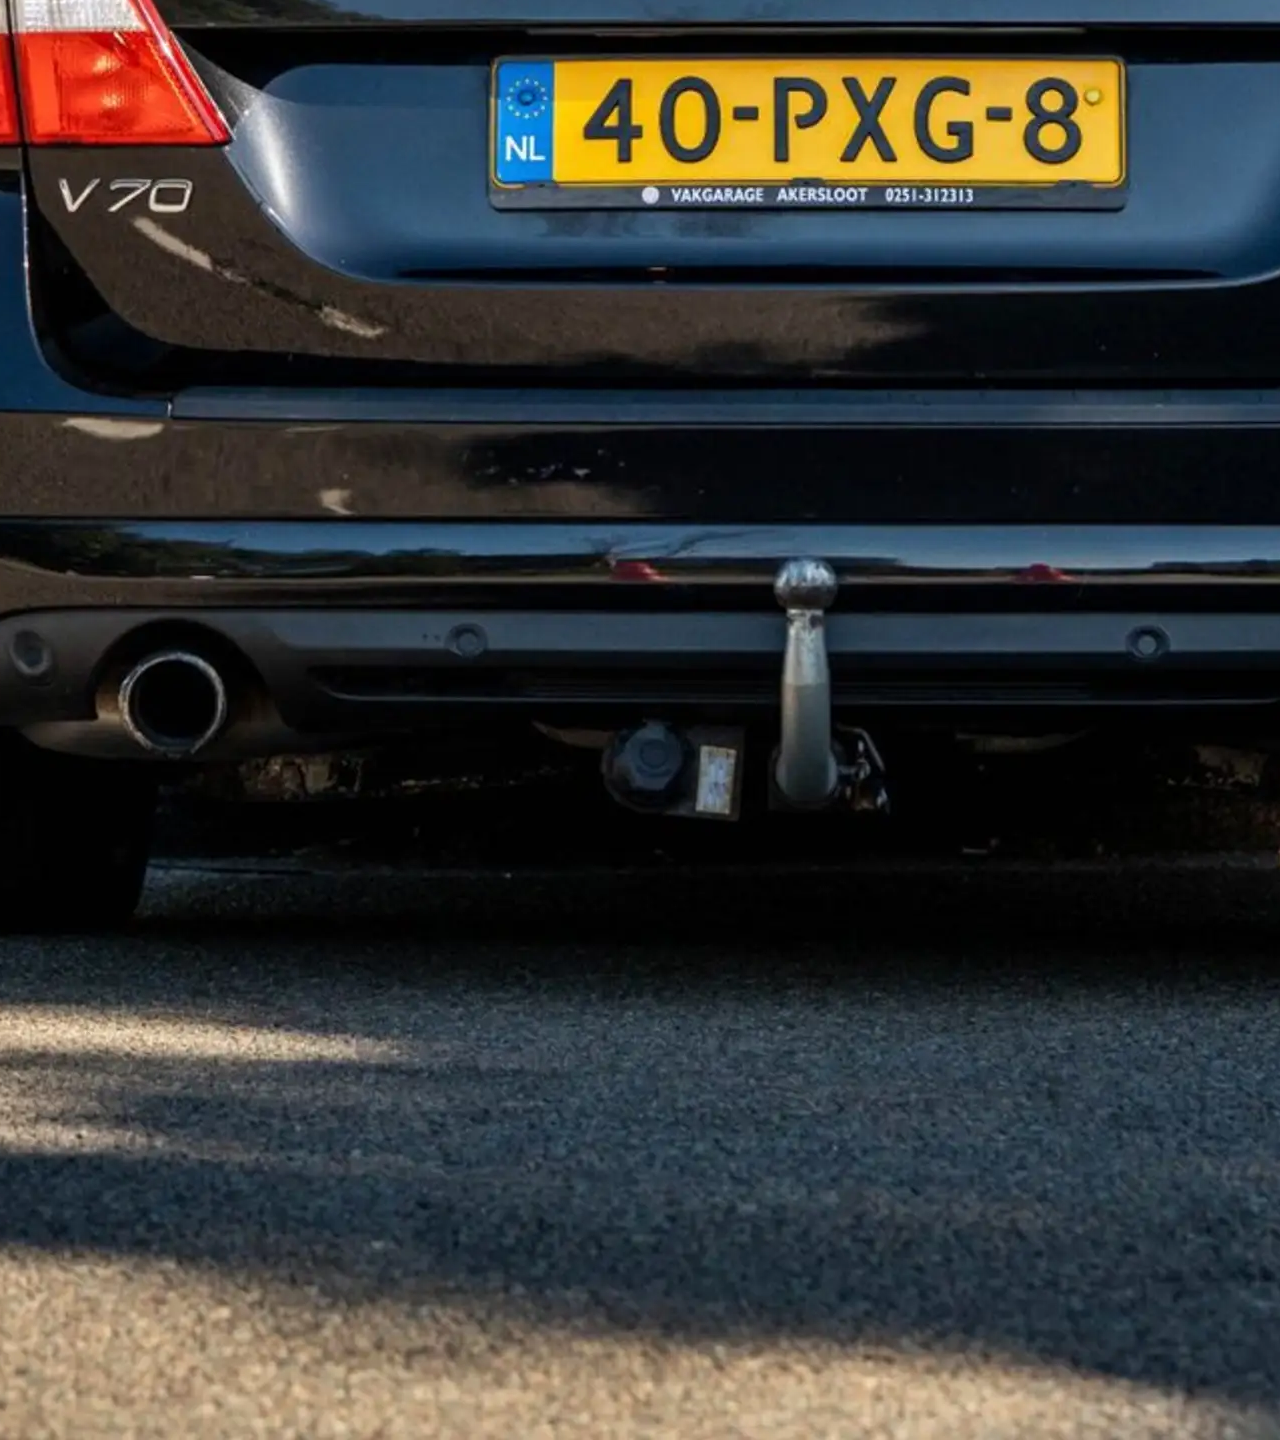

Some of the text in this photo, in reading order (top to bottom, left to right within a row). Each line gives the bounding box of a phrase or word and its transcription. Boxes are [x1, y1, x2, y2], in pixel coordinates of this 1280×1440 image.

[582, 76, 1082, 164] 40-PXG-8
[505, 136, 546, 162] NL
[671, 187, 974, 203] VAKGARAGE AKERSLOOT 0251-312313
